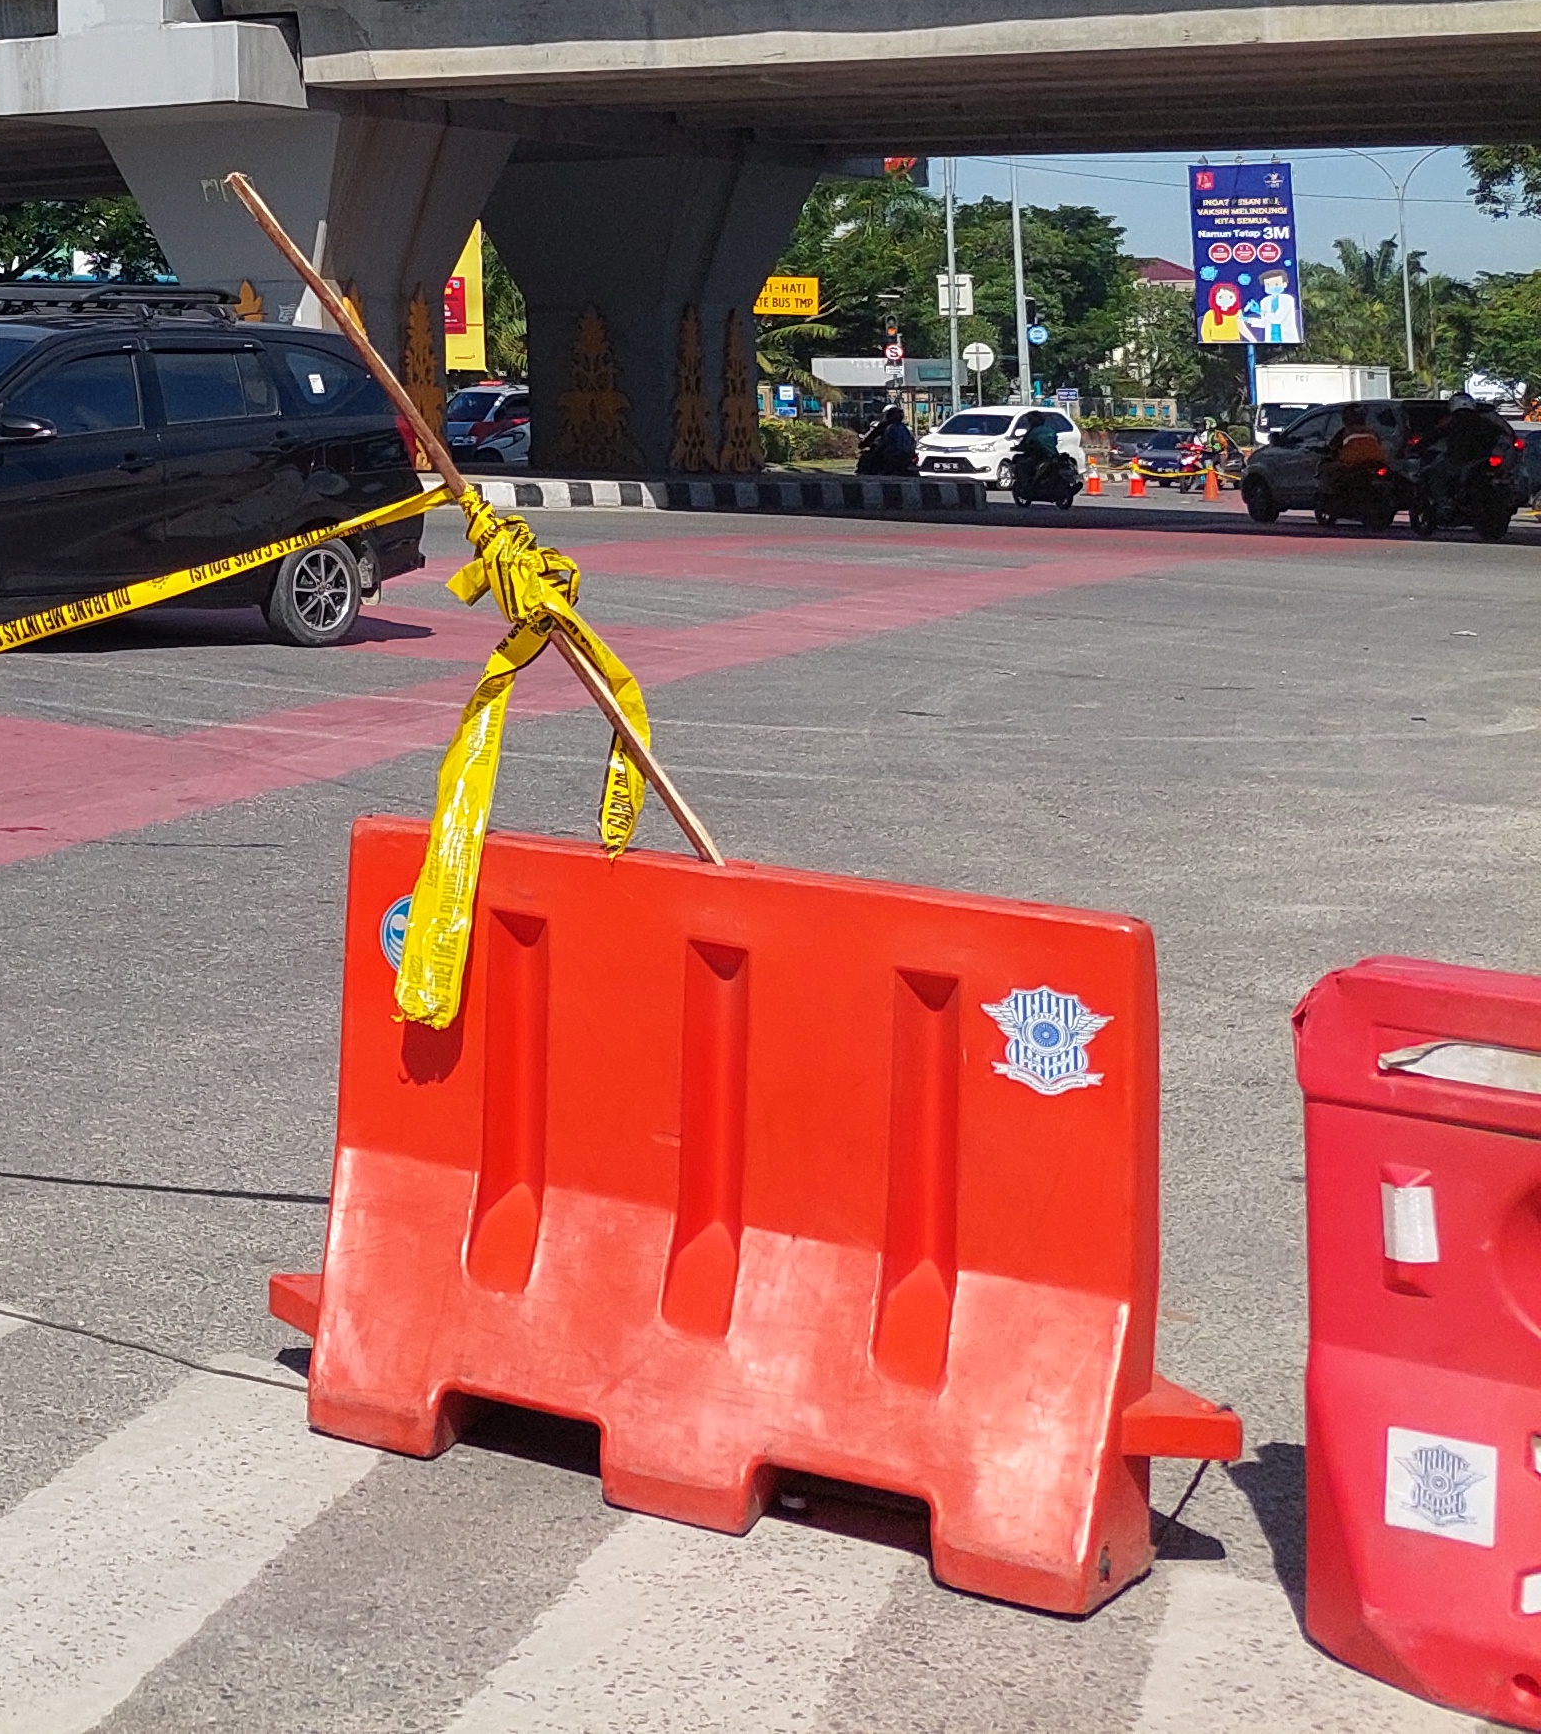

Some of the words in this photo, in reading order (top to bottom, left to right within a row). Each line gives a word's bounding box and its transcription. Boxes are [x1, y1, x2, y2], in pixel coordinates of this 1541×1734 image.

[1231, 207, 1288, 215] MELINDUNGI
[1214, 217, 1235, 225] KITA
[1197, 230, 1232, 238] Namun
[1232, 229, 1261, 239] Tetap
[1262, 226, 1290, 240] 3M
[781, 283, 806, 295] HATI
[772, 297, 791, 308] BUS
[794, 297, 814, 309] TMP
[67, 586, 132, 624] DILARANG
[5, 606, 67, 643] MELINTAS
